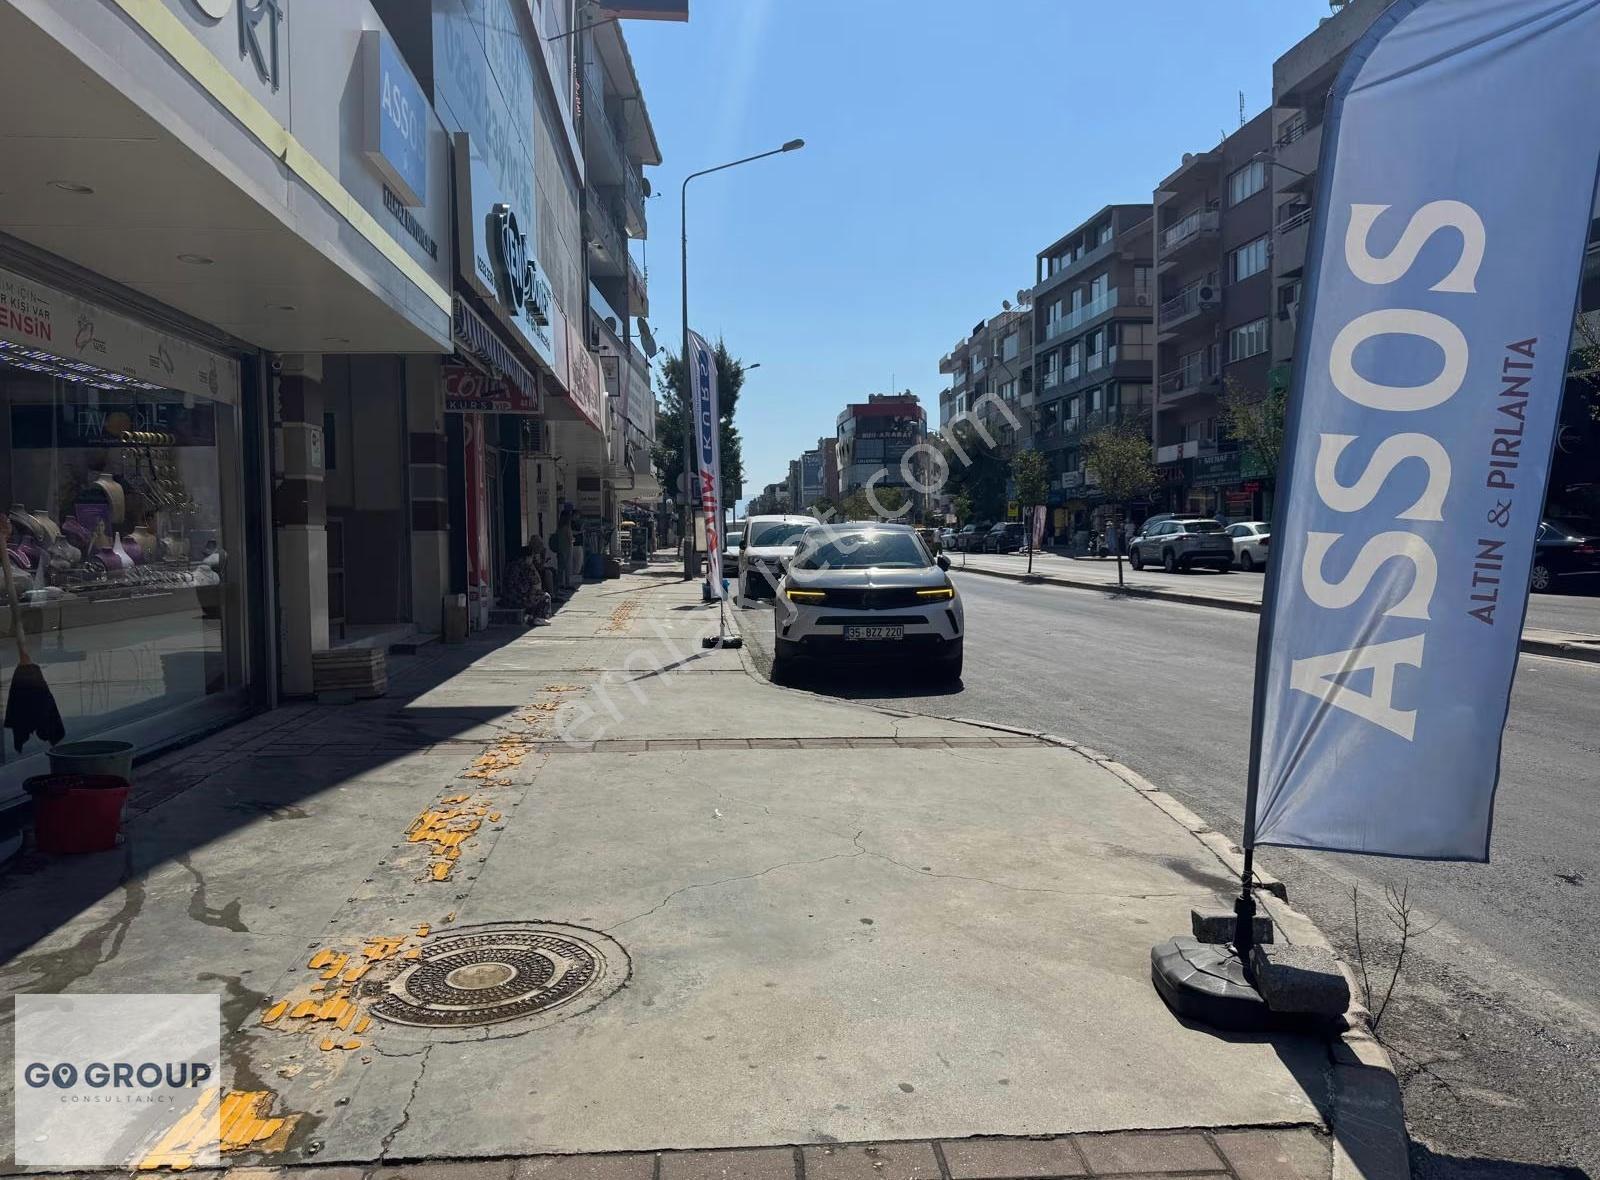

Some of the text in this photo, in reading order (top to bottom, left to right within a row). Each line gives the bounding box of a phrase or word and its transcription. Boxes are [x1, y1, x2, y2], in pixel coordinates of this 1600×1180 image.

[382, 71, 424, 162] ASSOS
[32, 305, 50, 320] VAR
[1290, 199, 1486, 742] ASSOS
[1466, 336, 1538, 625] ALTIN & PIRLANTA
[848, 627, 861, 638] 35
[885, 627, 902, 637] 220
